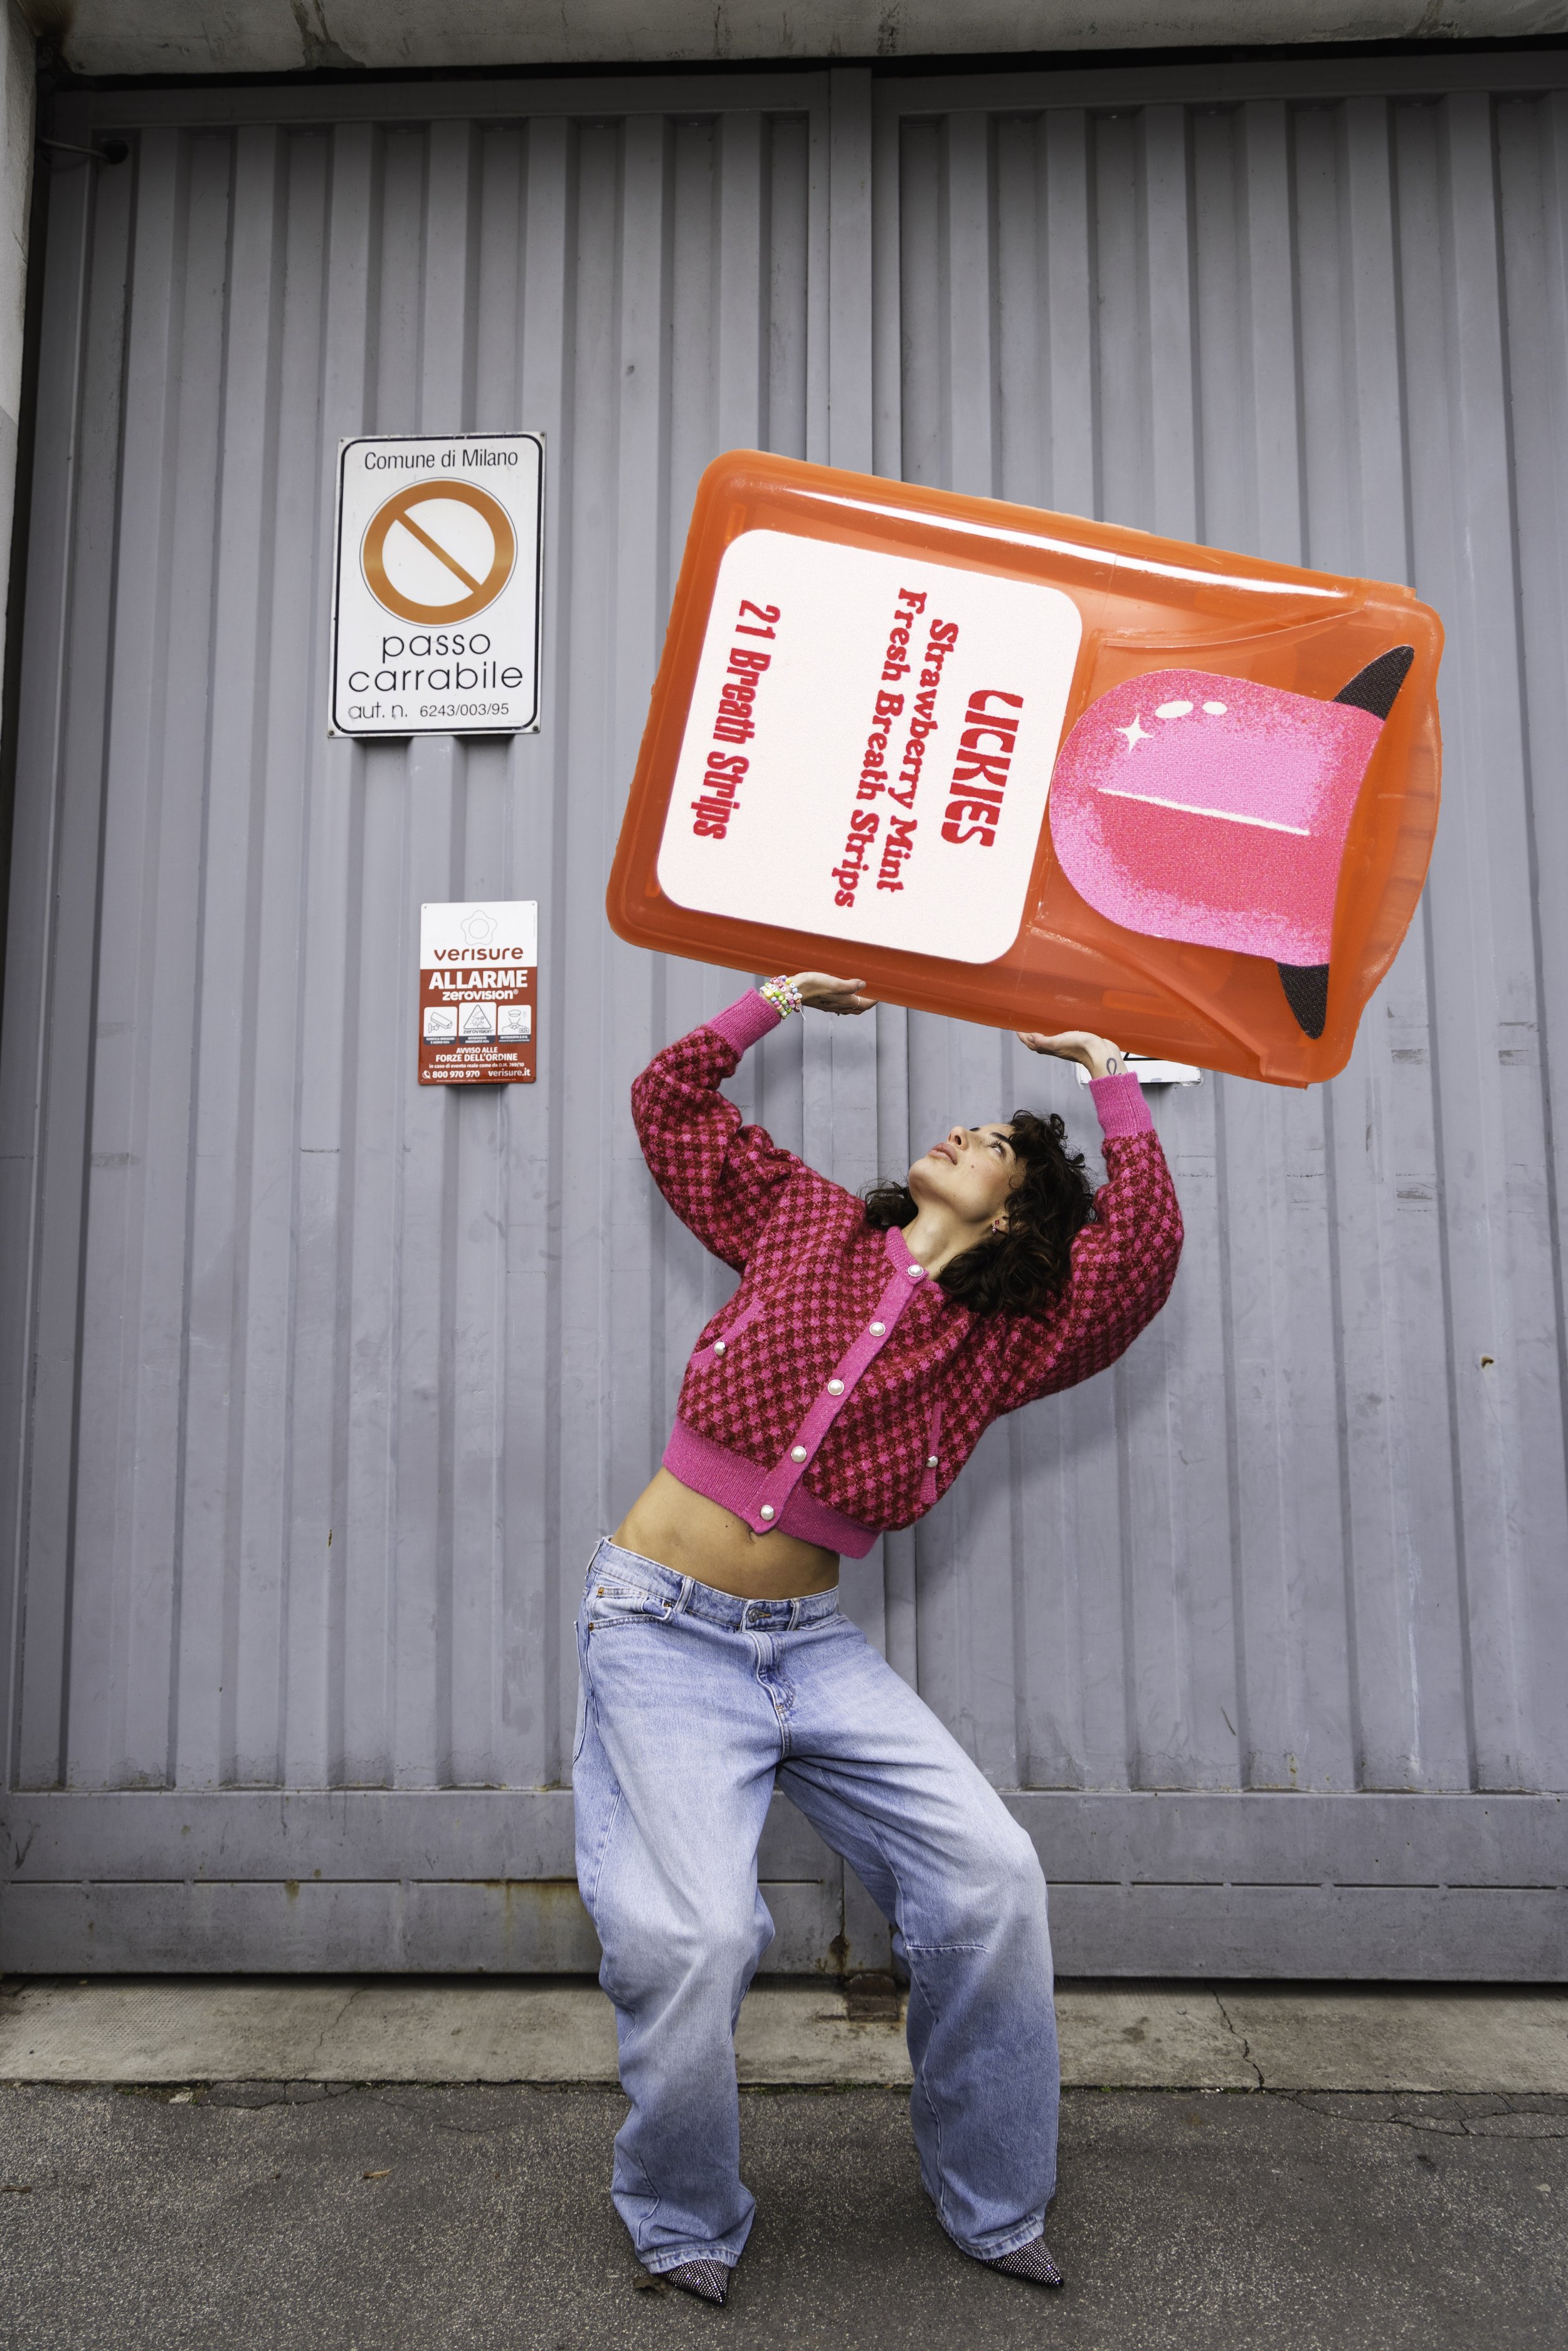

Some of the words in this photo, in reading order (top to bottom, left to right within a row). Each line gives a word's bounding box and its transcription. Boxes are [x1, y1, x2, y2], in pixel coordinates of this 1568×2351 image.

[364, 452, 435, 470] Comune
[441, 449, 455, 467] di
[462, 448, 518, 467] Milano
[735, 600, 781, 639] 21
[881, 588, 928, 681] Fresh
[382, 634, 490, 664] passo
[348, 661, 523, 693] carrabile
[712, 647, 771, 745] Breath
[348, 702, 385, 719] aut.
[391, 704, 408, 718] n.
[420, 703, 509, 717] 6243/003/95
[887, 619, 959, 810] Strawberry
[856, 689, 905, 800] Breath
[940, 689, 1024, 847] LICKIES
[691, 751, 750, 840] Strips
[832, 809, 880, 908] Strips
[876, 815, 918, 893] Mint
[433, 947, 524, 961] verisure
[428, 970, 528, 990] ALLARME
[435, 1054, 462, 1062] FORZE
[488, 1068, 531, 1077] verisure.it
